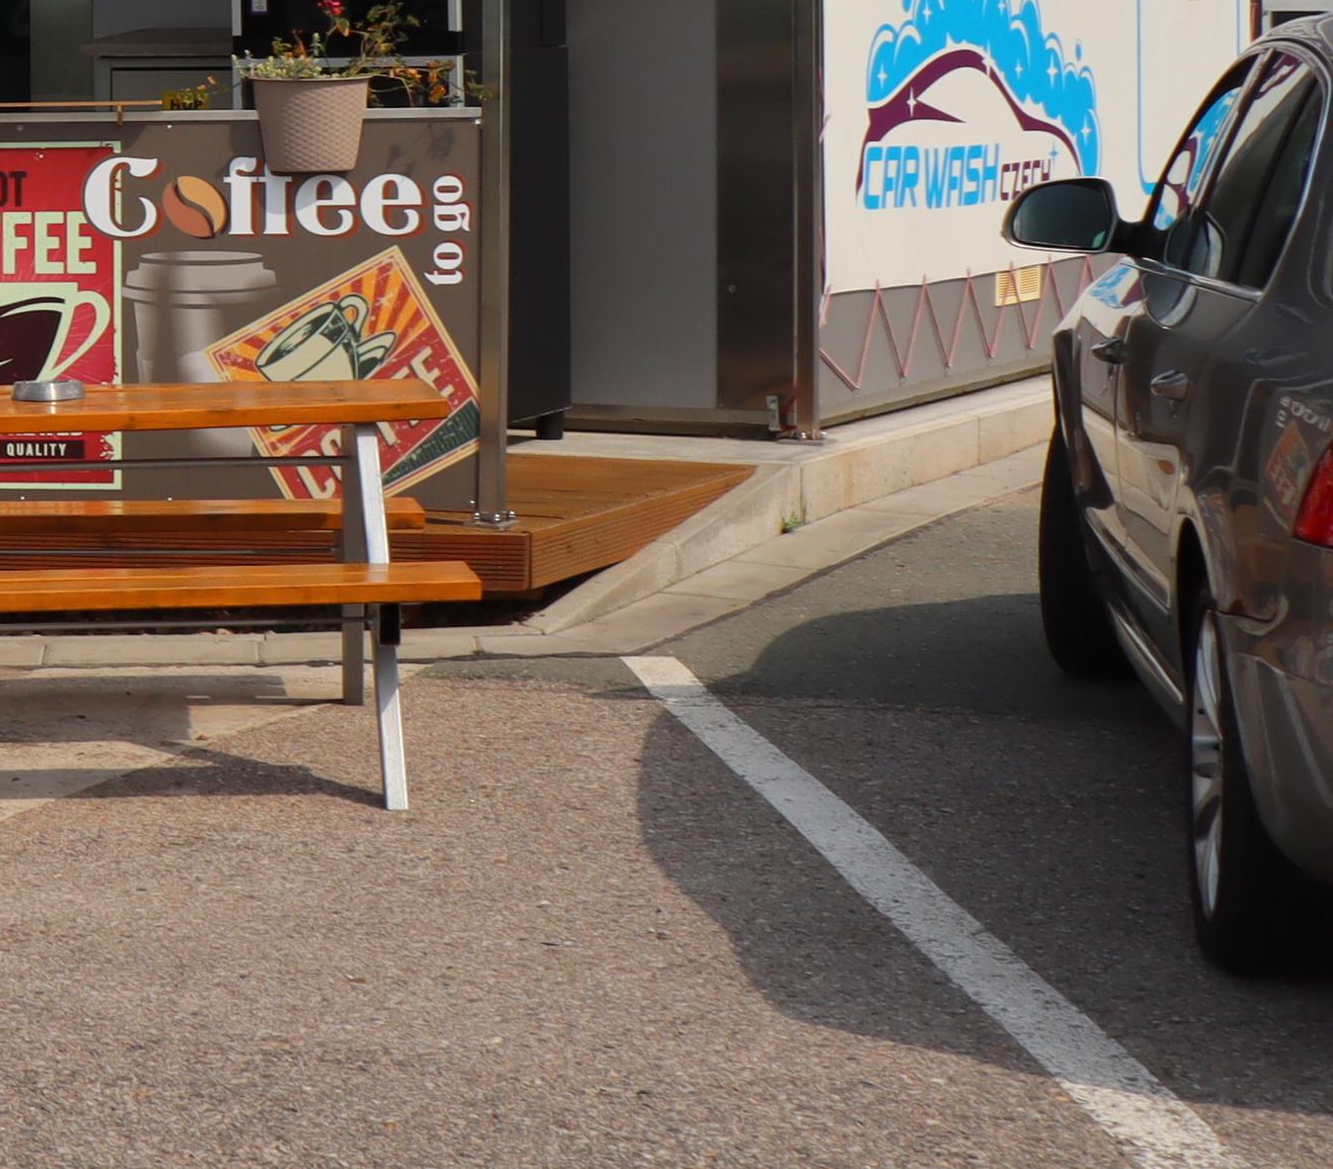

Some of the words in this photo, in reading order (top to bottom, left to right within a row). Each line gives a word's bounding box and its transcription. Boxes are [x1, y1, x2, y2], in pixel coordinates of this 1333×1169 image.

[431, 174, 472, 232] go
[424, 240, 465, 287] to
[6, 442, 67, 457] QUALITY
